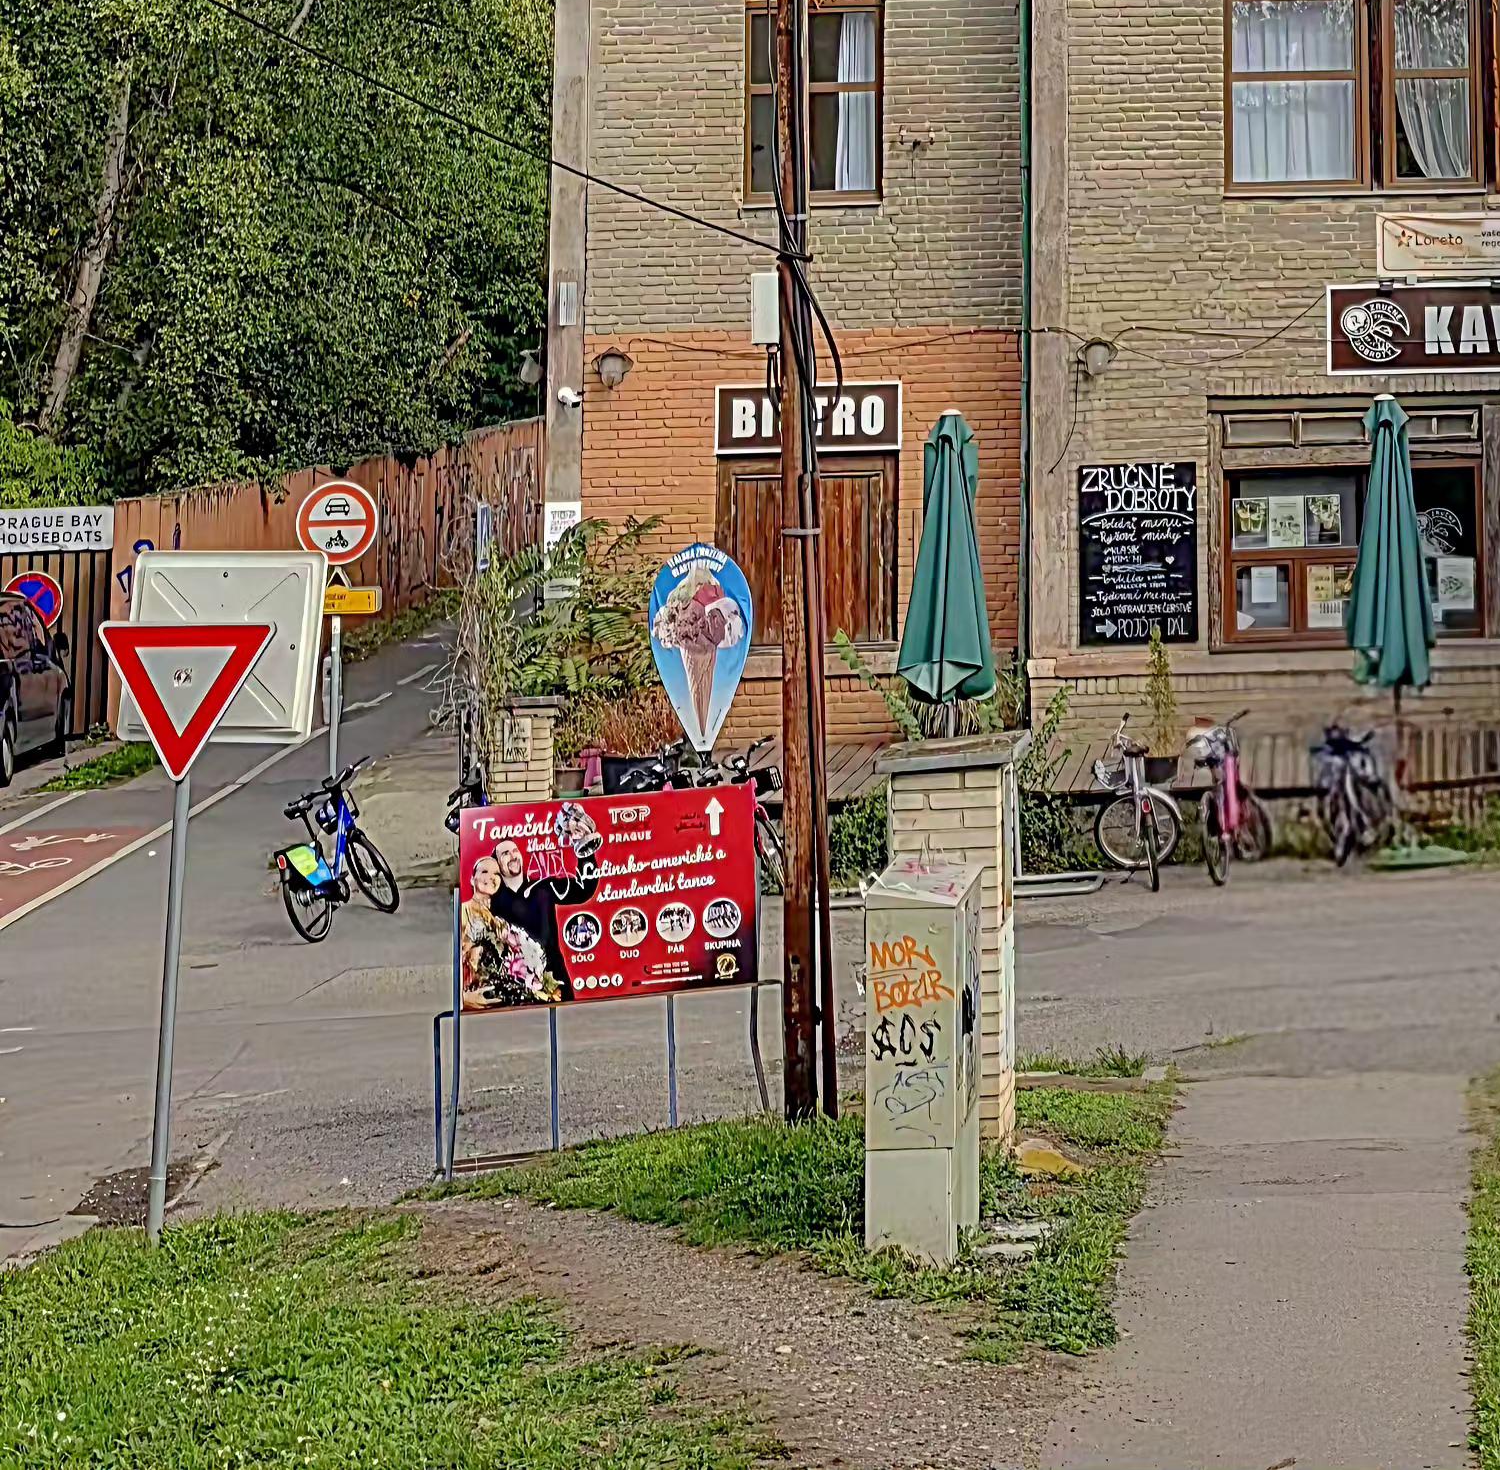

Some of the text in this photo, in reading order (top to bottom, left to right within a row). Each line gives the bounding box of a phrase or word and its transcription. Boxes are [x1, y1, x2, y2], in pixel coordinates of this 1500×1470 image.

[1415, 232, 1464, 247] Loreto
[732, 394, 885, 439] BITRO
[1105, 485, 1197, 512] DOBROTY
[71, 514, 103, 527] BAY
[608, 805, 651, 824] TOP
[473, 812, 554, 841] Taneční
[608, 830, 653, 843] PRAGUE
[582, 844, 714, 880] Latinsko-americké
[715, 849, 727, 860] a
[596, 874, 675, 903] standardní
[676, 874, 716, 890] tance
[619, 948, 640, 959] DUO
